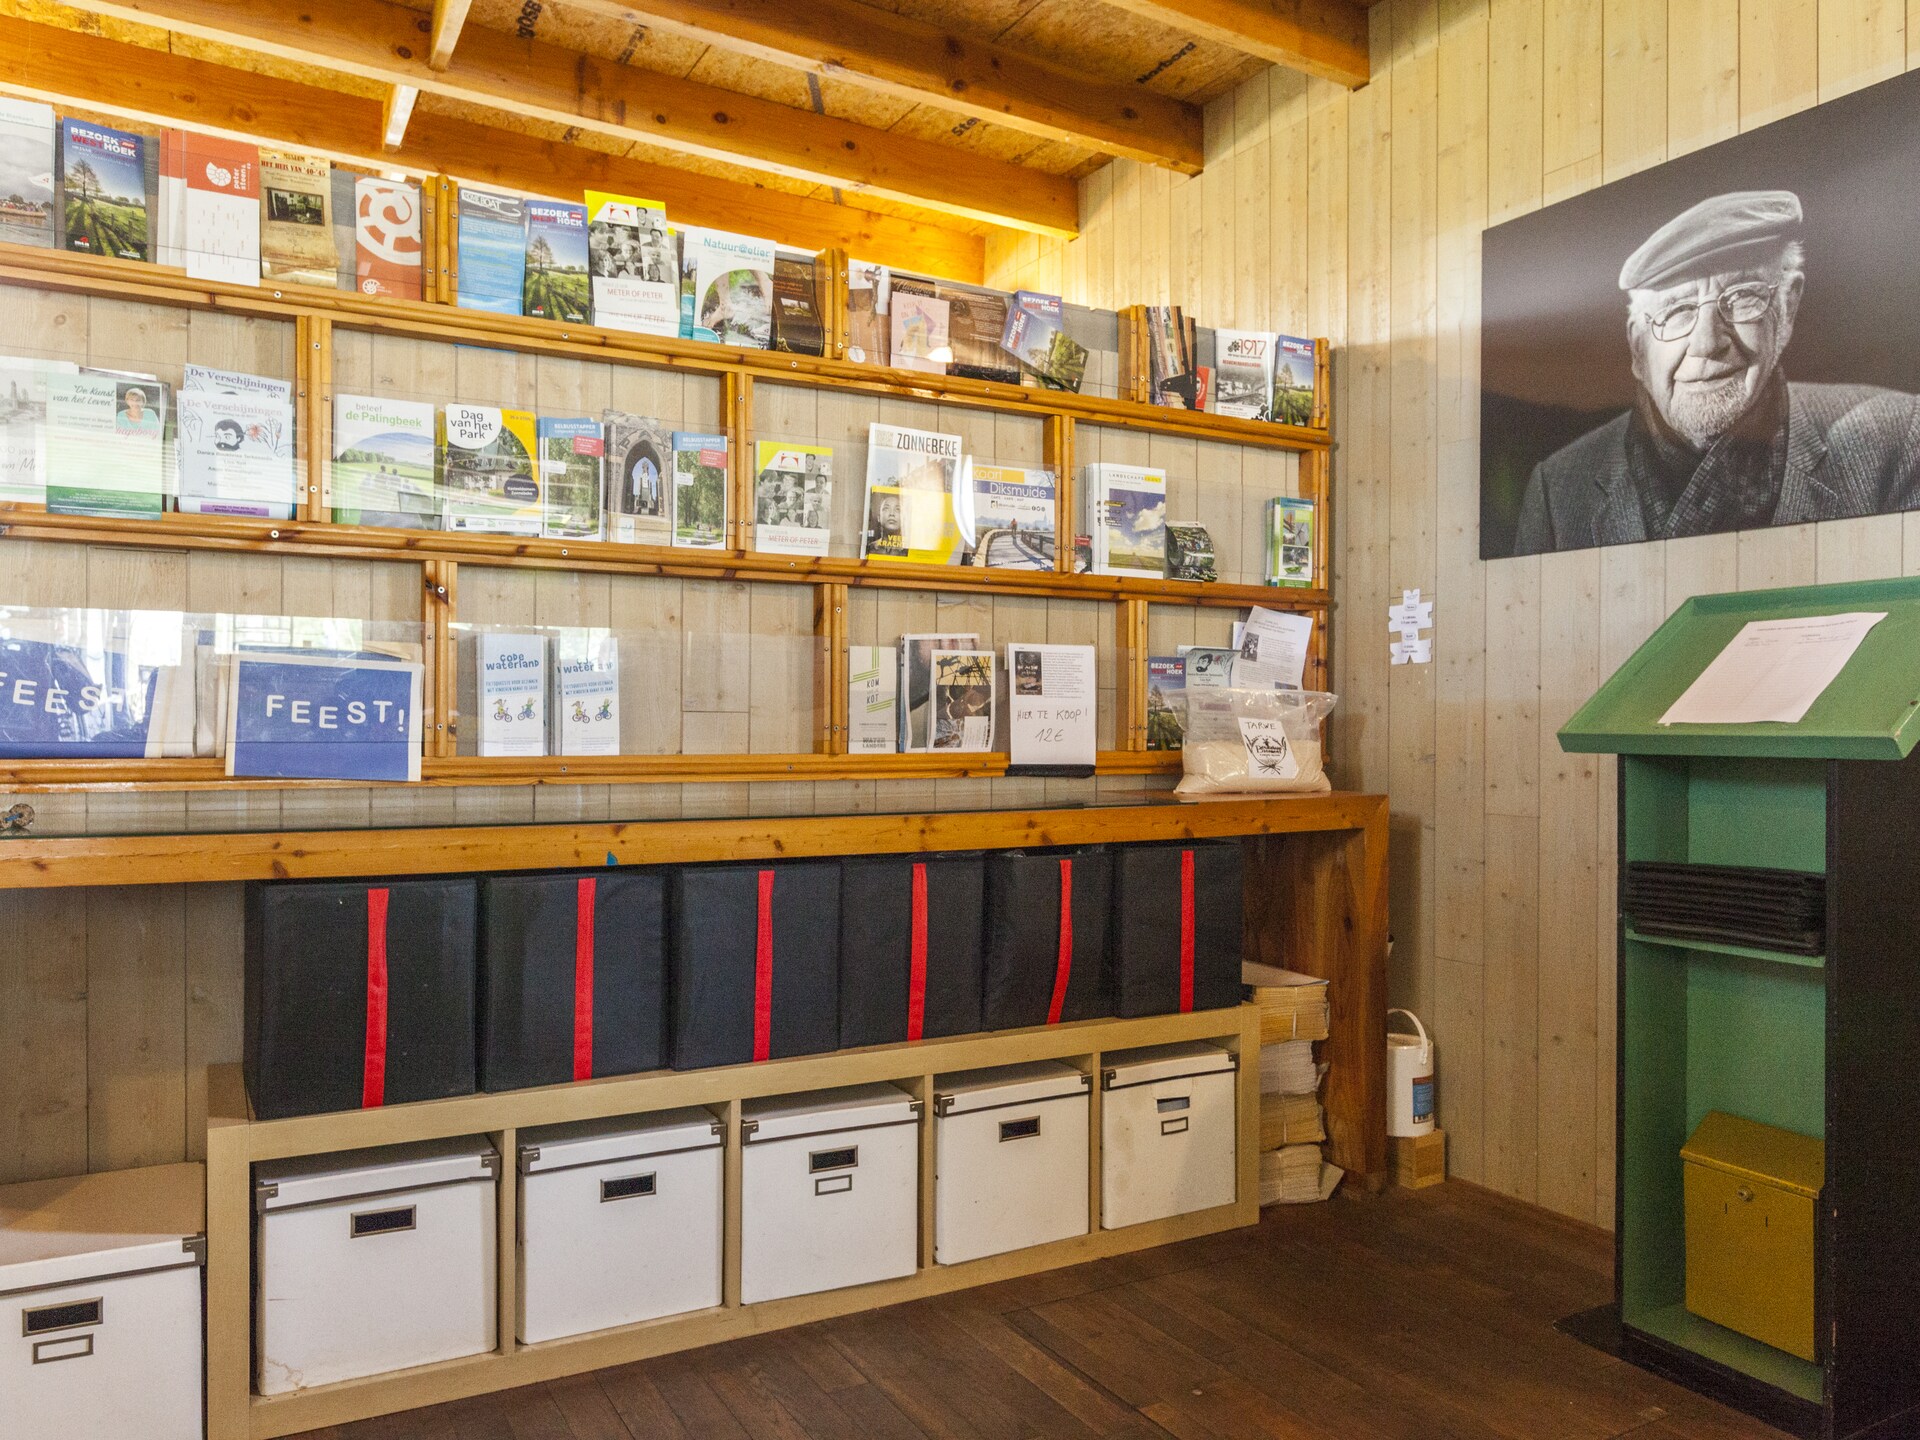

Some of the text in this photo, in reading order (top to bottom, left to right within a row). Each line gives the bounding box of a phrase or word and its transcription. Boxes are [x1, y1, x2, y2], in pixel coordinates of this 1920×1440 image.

[1136, 41, 1198, 85] Norbord
[70, 127, 119, 146] BEZOEK
[71, 135, 137, 158] WESTHOEK
[290, 164, 302, 173] VAN
[233, 168, 241, 190] peter
[530, 207, 569, 218] BEZOEK
[607, 288, 663, 300] METER OF PETER
[1239, 339, 1267, 356] 1917
[190, 368, 205, 377] De
[207, 371, 286, 392] Verschijningen
[90, 388, 115, 397] Kunst
[71, 395, 85, 404] het
[186, 399, 283, 417] De Verschijningen
[355, 403, 382, 413] beleef
[345, 410, 423, 428] de Palingbeek
[460, 409, 484, 423] Dag
[450, 418, 470, 428] van
[474, 415, 493, 432] het
[460, 427, 486, 440] Park
[896, 433, 958, 457] ZONNEBEKE
[989, 482, 1047, 499] Diksmuide
[768, 535, 789, 543] METER
[800, 537, 818, 545] PETER
[1150, 662, 1175, 670] BEZOEK
[866, 678, 880, 688] KOM
[866, 694, 879, 704] KOT
[265, 694, 406, 733] FEEST!
[1017, 709, 1033, 722] HIER
[1037, 710, 1048, 720] TE
[1245, 721, 1277, 730] TARWE
